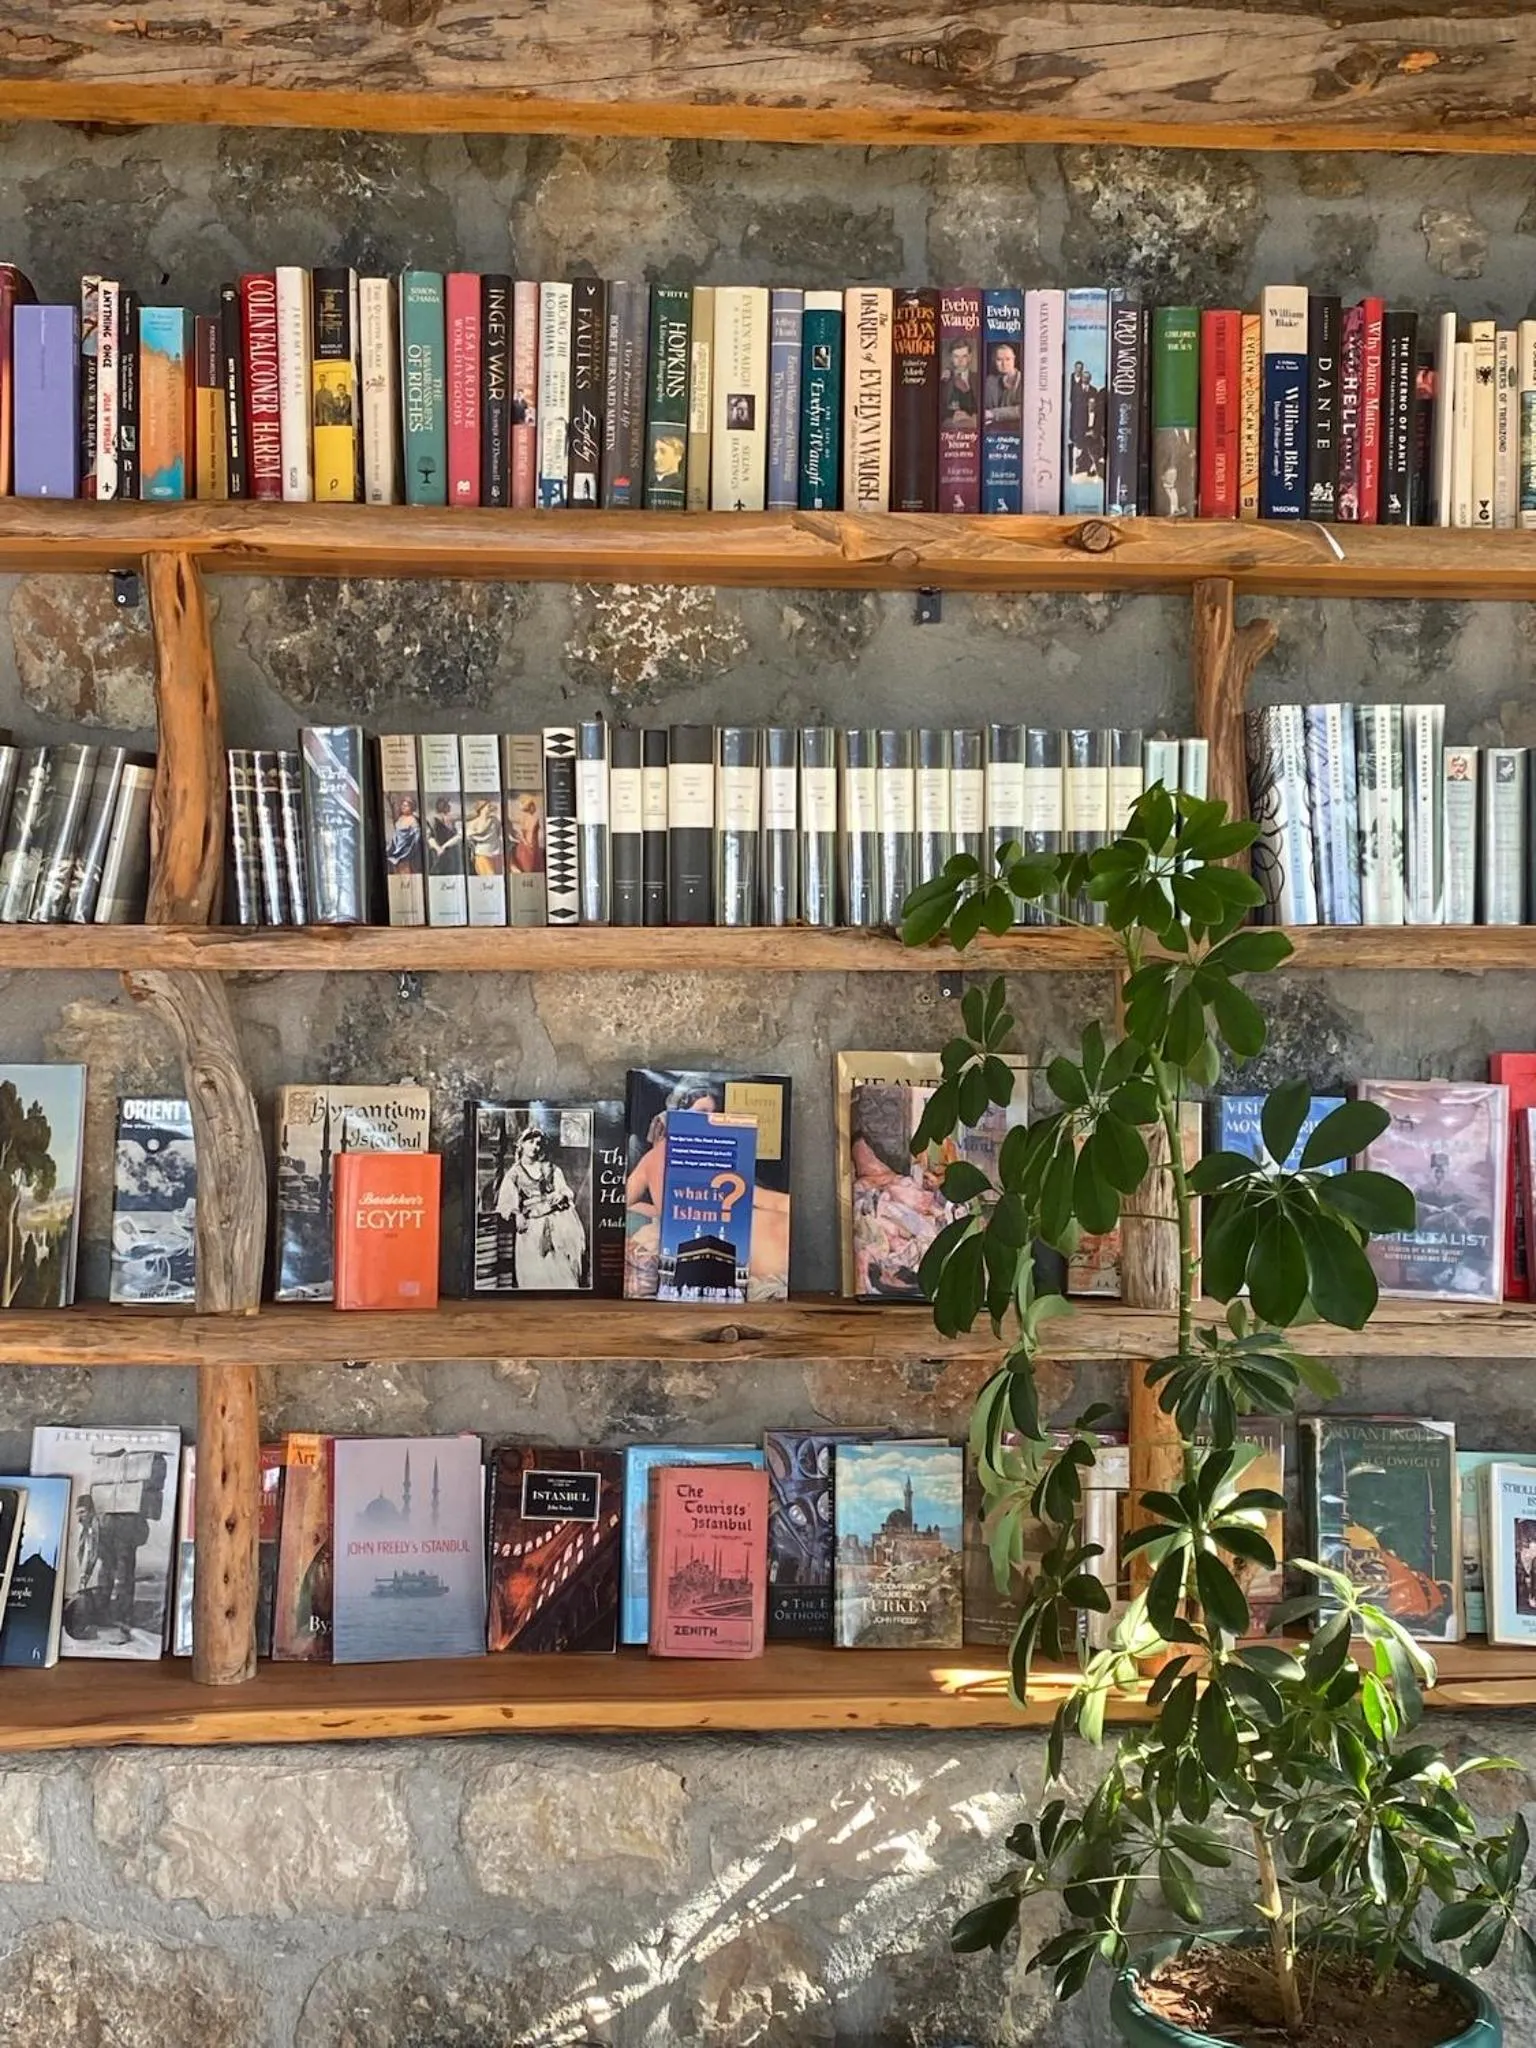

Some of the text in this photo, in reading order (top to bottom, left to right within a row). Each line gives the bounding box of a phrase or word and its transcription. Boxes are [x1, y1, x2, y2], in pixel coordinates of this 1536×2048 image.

[879, 313, 888, 327] The
[940, 312, 980, 331] Waugh
[941, 298, 979, 316] Evelyn
[986, 304, 1020, 320] Evelyn
[1269, 308, 1304, 319] William
[1275, 318, 1300, 328] Blake
[103, 290, 112, 368] ANYTHING ONCE
[658, 325, 667, 357] Literary
[741, 294, 752, 388] EVELYN WAUGH
[893, 322, 935, 341] EVELYN
[987, 318, 1021, 334] Waugh
[488, 289, 504, 400] INGE'S WAR
[576, 308, 592, 390] FAULKS
[667, 322, 687, 398] HOPKINS
[894, 340, 935, 356] WAUGH
[1038, 301, 1048, 391] ALEXANDER WAUGH
[1113, 310, 1136, 395] MAD WORLD
[1245, 336, 1255, 372] EVELYN
[247, 280, 281, 478] COLIN FALCONER HAREM
[408, 345, 423, 432] OF RICHES
[454, 319, 463, 425] WORLDLY GOODS
[465, 316, 475, 428] LISA JARDINE
[606, 315, 617, 450] ROBERT BERNARD MARTIN
[1364, 321, 1381, 447] Why Dante Matters
[1499, 355, 1507, 390] TOWERS
[855, 293, 880, 501] DIARIES of EVELYN WAUGH
[1245, 390, 1255, 430] DUNCAN
[1317, 357, 1332, 449] DANTE
[1343, 377, 1356, 435] HELL
[1397, 337, 1409, 473] THE INFERNO OF DANTE
[1499, 393, 1507, 403] OF
[805, 378, 823, 485] Evelyn Waugh
[1283, 387, 1299, 447] William
[1499, 407, 1507, 453] TREBIZOND
[731, 438, 741, 490] HASTINGS
[742, 446, 750, 482] SELINA
[1283, 450, 1298, 491] Blake
[123, 1100, 182, 1120] ORIENT
[310, 1096, 426, 1125] Byzantium
[366, 1120, 398, 1133] and
[349, 1128, 421, 1149] Istanbul
[673, 1187, 708, 1201] what
[713, 1187, 726, 1201] is
[356, 1210, 425, 1229] EGYPT
[672, 1205, 717, 1223] Islam
[292, 1451, 316, 1465] Art
[1386, 1454, 1440, 1468] DWIGHT
[532, 1489, 590, 1502] ISTANBUL
[676, 1484, 704, 1498] The
[691, 1517, 753, 1532] Istanbul
[347, 1542, 374, 1557] JOHN
[421, 1538, 471, 1553] ISTANBUL
[863, 1599, 930, 1614] TURKEY
[674, 1625, 718, 1637] ZENITH
